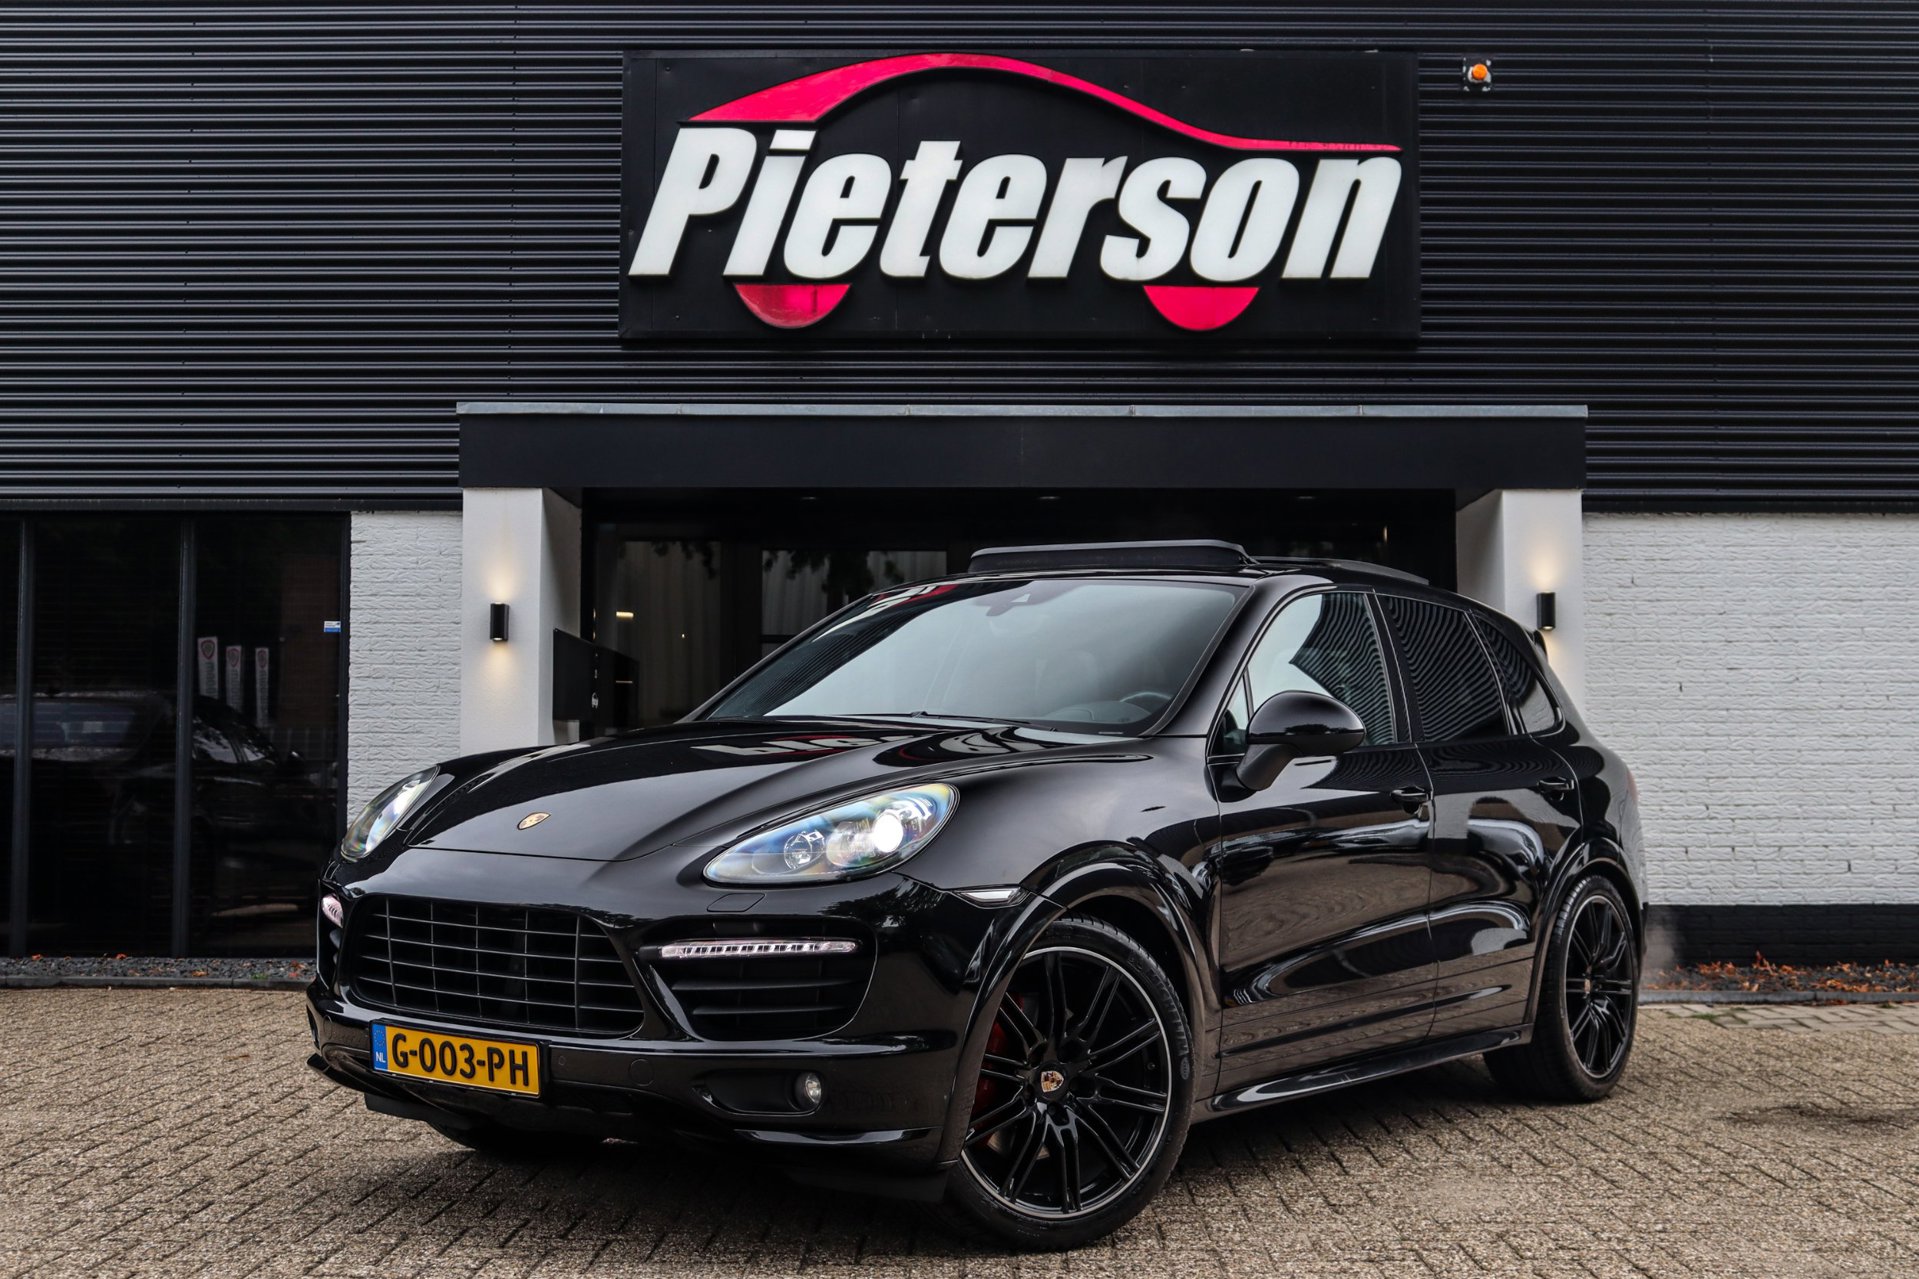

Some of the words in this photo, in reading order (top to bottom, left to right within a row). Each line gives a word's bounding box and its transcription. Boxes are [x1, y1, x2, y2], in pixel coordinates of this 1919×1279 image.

[629, 128, 1402, 281] Pieterson
[375, 1052, 386, 1063] NL
[392, 1033, 529, 1086] G-003-PH
